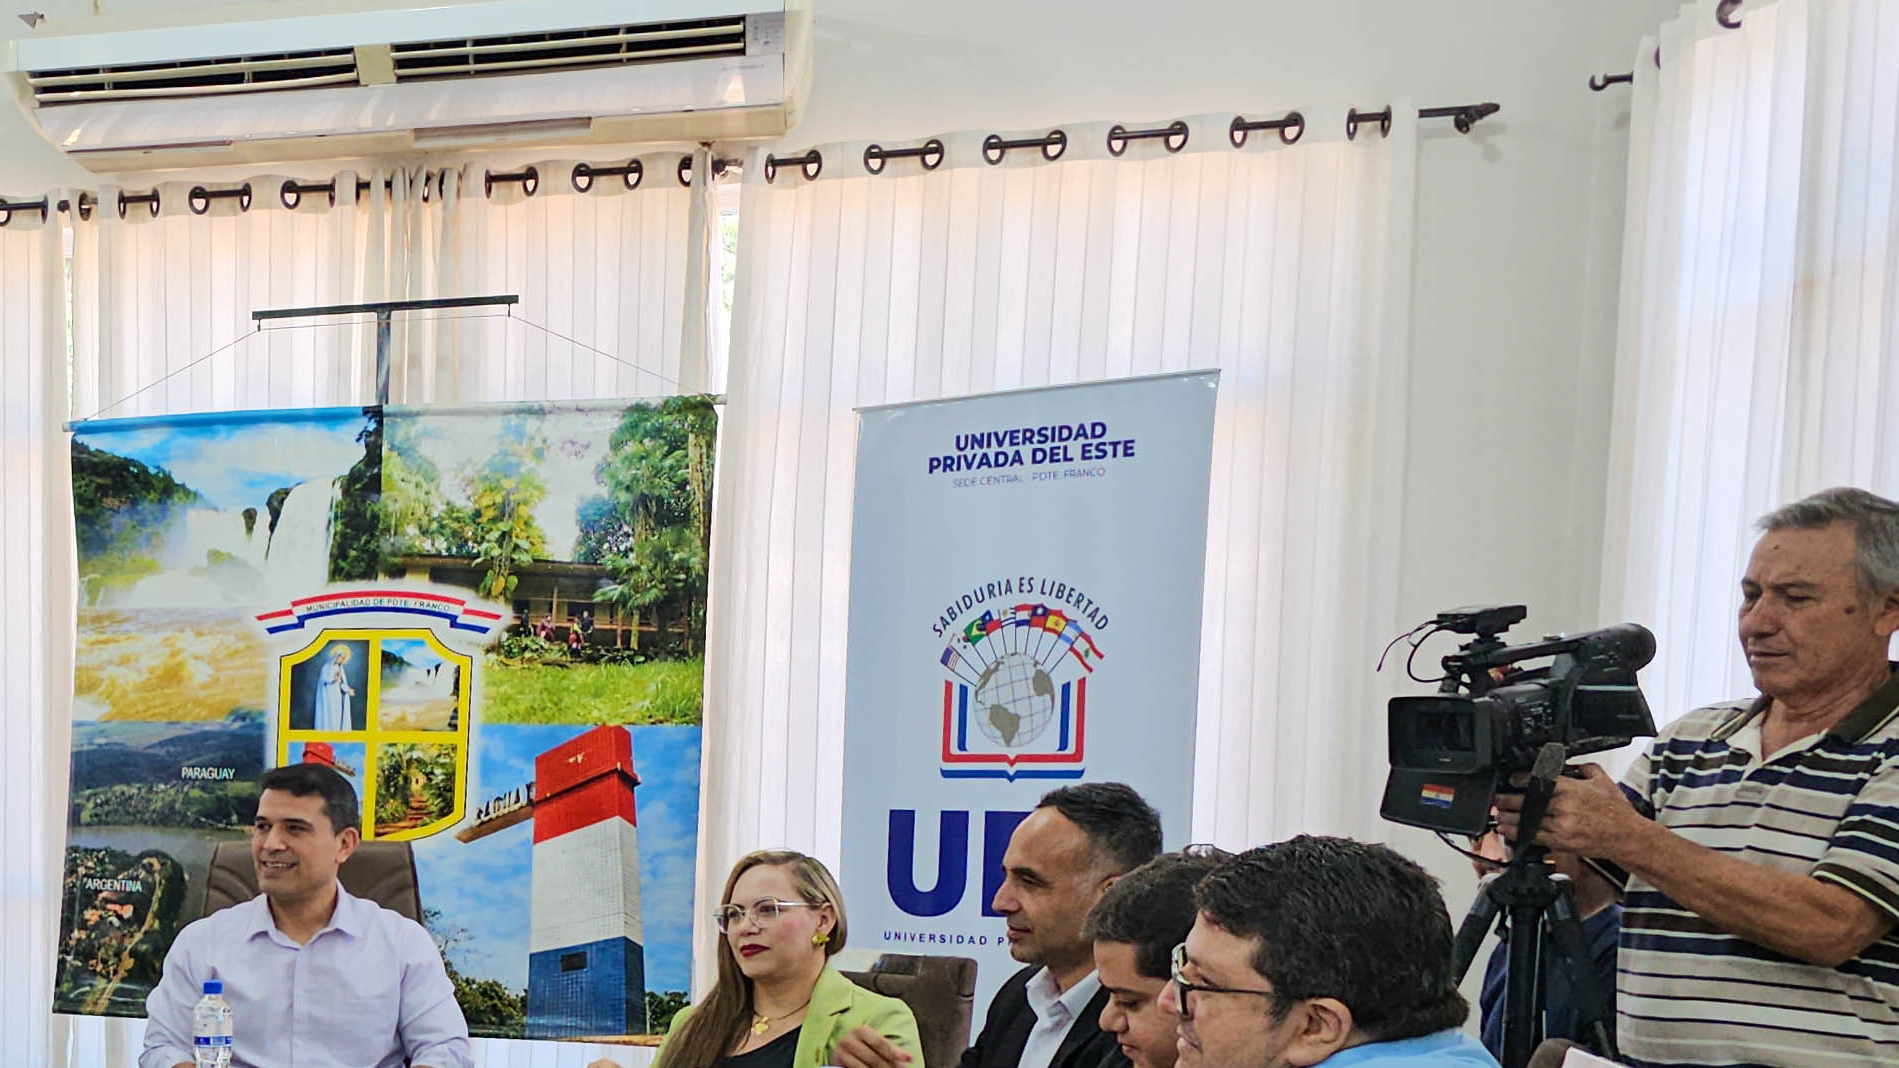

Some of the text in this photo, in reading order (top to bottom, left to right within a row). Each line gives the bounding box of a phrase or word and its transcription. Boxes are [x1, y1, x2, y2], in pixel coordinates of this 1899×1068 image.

[955, 421, 1107, 451] UNIVERSIDAD
[928, 439, 1136, 474] PRIVADA DEL ESTE
[952, 477, 977, 488] SEDE
[979, 473, 1023, 486] CENTRAL
[1063, 467, 1106, 479] FRANCO
[306, 599, 371, 612] MUNICIPALIDAD
[373, 598, 383, 606] DE
[413, 600, 450, 612] FRANCO
[932, 577, 1109, 638] SABIDURIA ES LIBERTAD
[181, 766, 236, 780] PARAGUAY
[85, 878, 143, 893] ARGENTINA
[884, 931, 987, 946] UNIVERSIDAD
